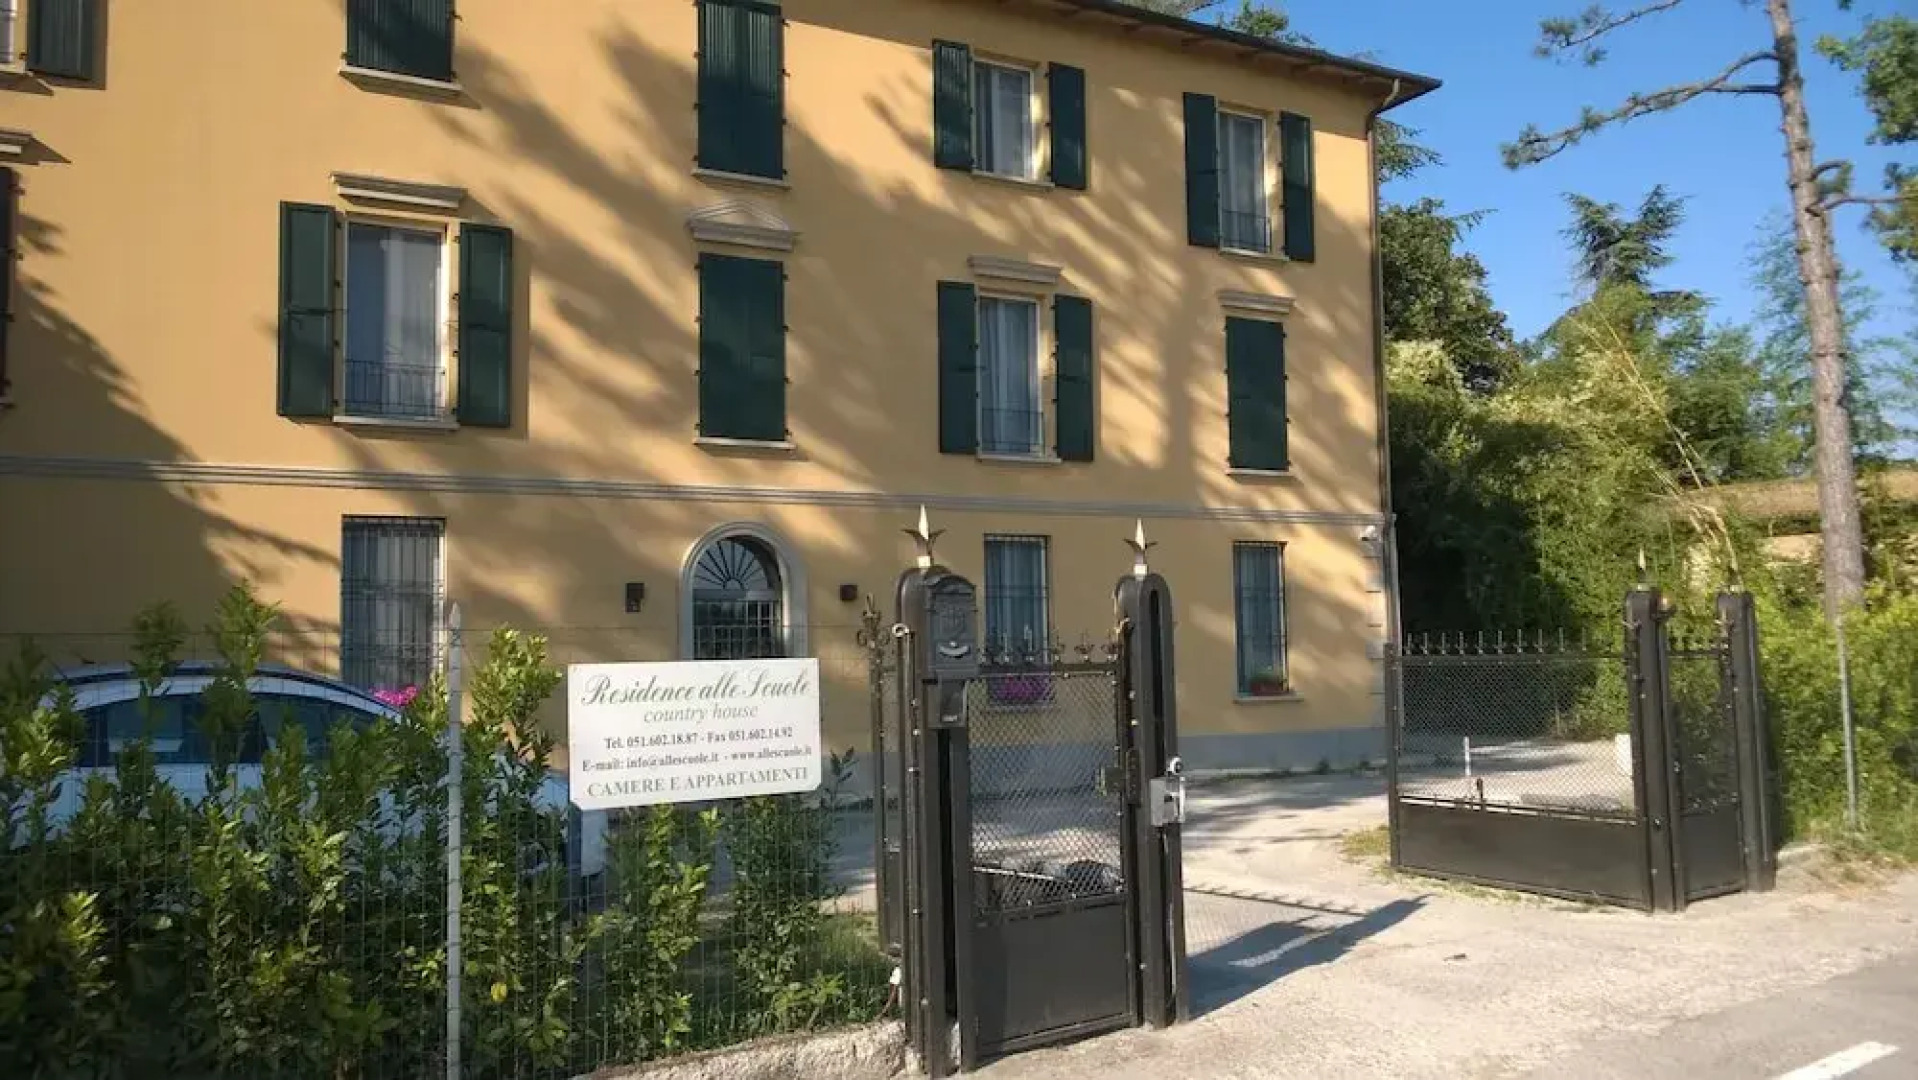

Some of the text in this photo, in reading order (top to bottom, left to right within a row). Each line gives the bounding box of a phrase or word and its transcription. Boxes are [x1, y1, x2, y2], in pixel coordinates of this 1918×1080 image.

[581, 666, 809, 705] Residence alle Scuole
[643, 703, 758, 724] country house
[604, 736, 624, 749] Tel.
[627, 732, 698, 747] 051.602.18.87
[707, 731, 726, 742] Fax
[583, 759, 624, 772] E-mail:
[588, 767, 807, 797] CAMERE E APPARTAMENTI
